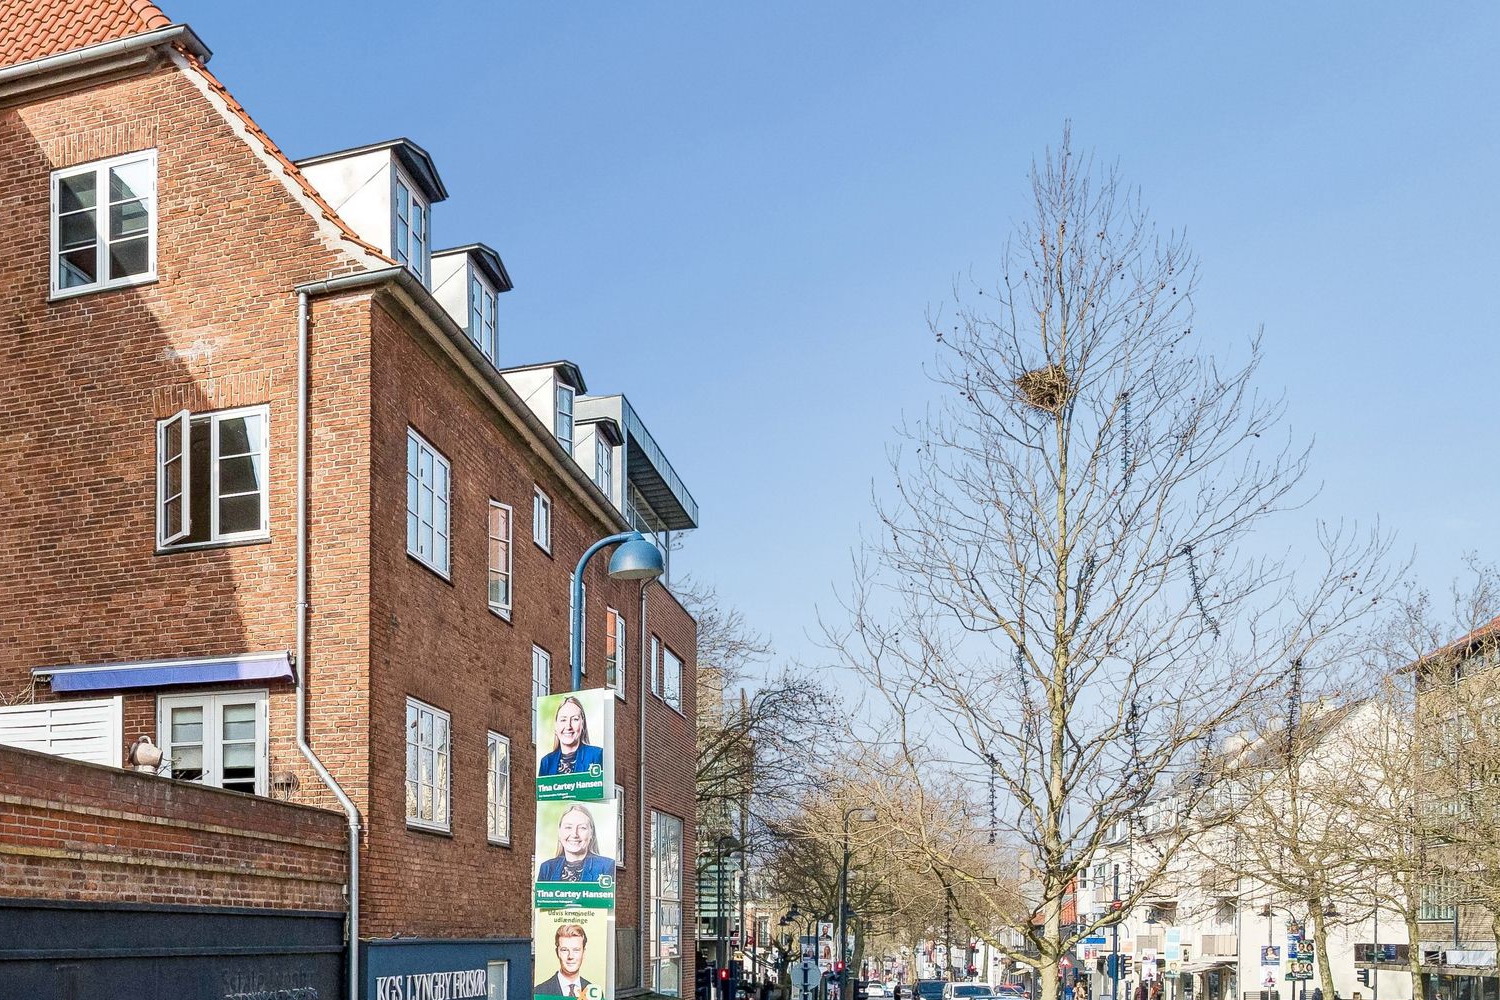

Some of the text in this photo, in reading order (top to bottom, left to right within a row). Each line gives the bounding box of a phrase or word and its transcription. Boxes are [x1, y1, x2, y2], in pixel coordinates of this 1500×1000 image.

[538, 784, 552, 792] Tina
[553, 783, 575, 791] Cartey
[555, 891, 581, 899] Cartey
[452, 969, 487, 1000] FRISØR
